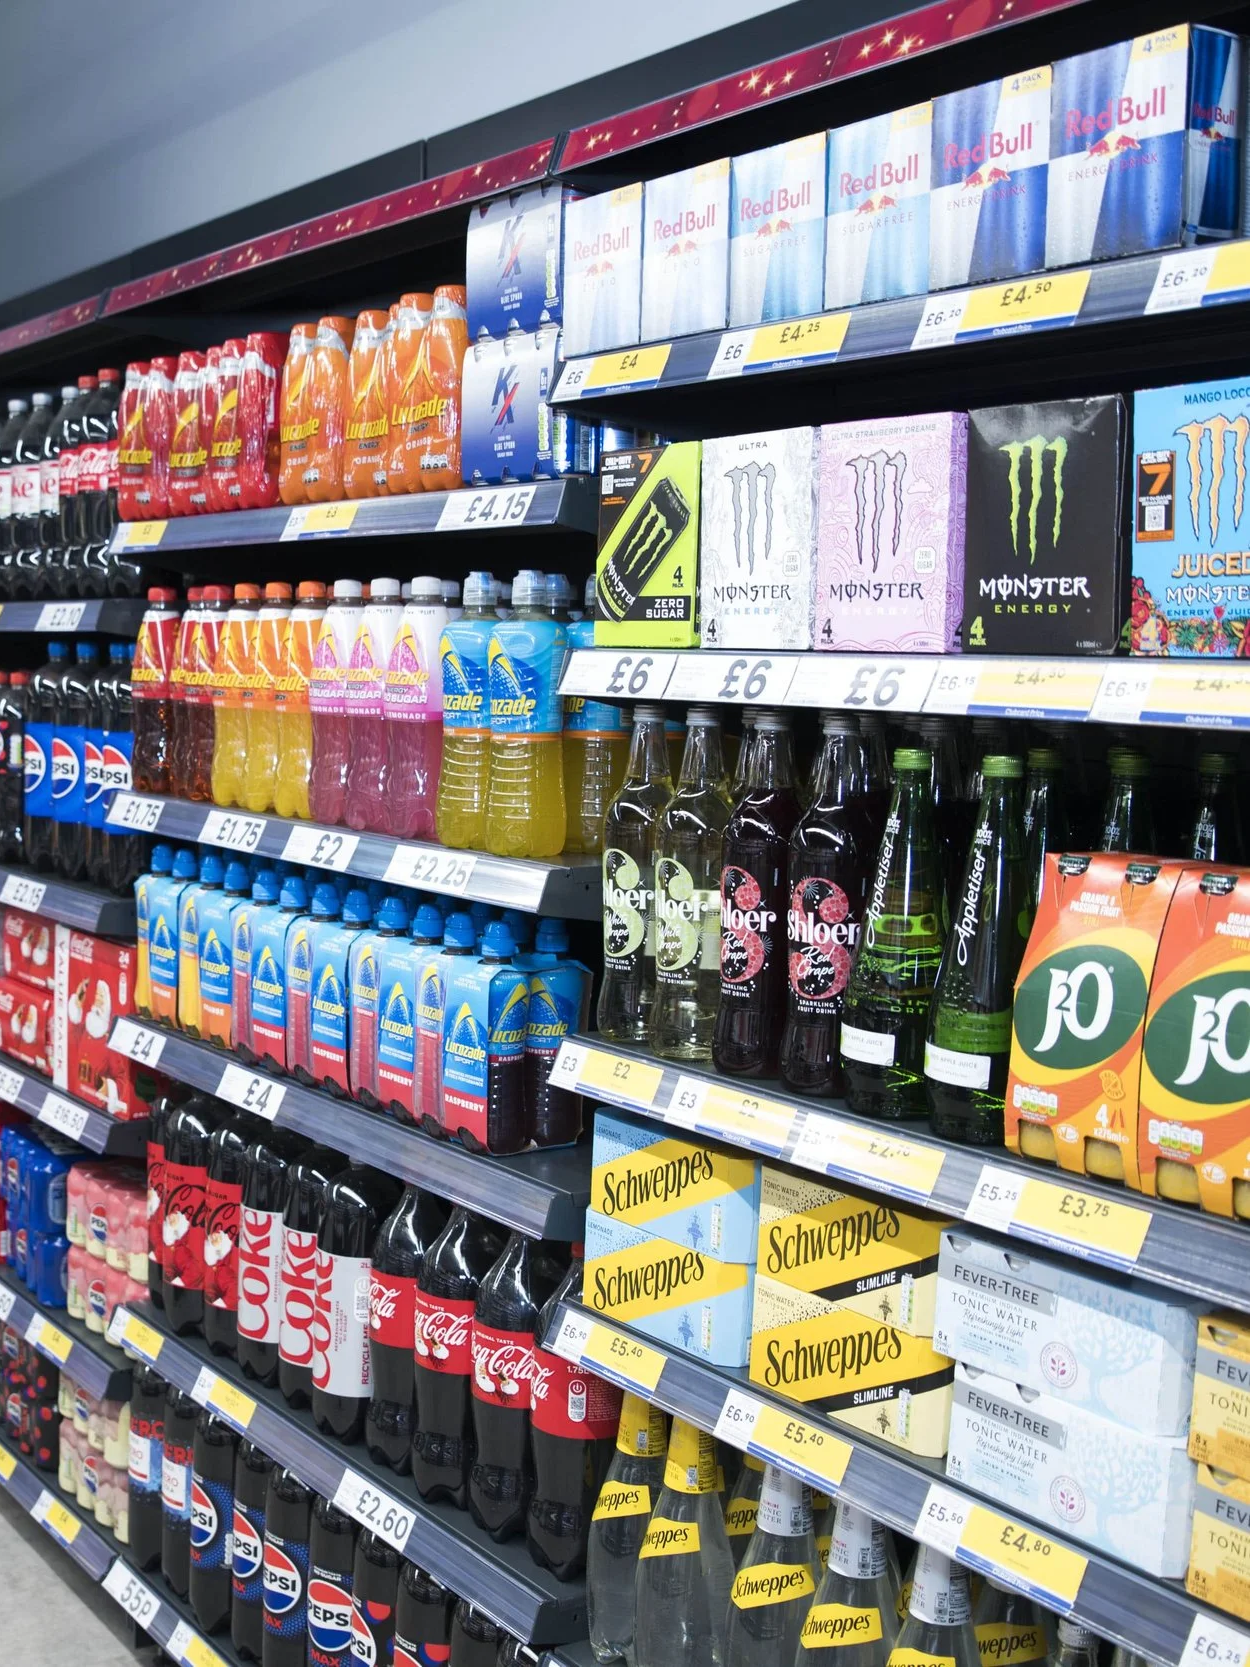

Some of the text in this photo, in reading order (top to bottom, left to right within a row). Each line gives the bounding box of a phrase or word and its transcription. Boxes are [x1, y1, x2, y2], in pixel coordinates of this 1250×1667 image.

[1155, 32, 1178, 45] PACK
[1066, 86, 1166, 139] Red Bull
[1193, 103, 1236, 126] Red Bull
[944, 122, 1032, 169] Red Bull
[840, 154, 918, 198] Red Bull
[1068, 162, 1114, 183] ENERGY
[741, 181, 811, 221] Red Bull
[654, 204, 715, 241] Red Bull
[842, 211, 914, 236] SUGARFREE
[574, 227, 629, 261] Red Bull
[620, 354, 638, 370] £4
[723, 343, 744, 360] £6
[566, 370, 582, 385] £6
[1184, 391, 1222, 405] MANGO
[738, 441, 768, 451] ULTRA
[464, 492, 530, 523] £4.15
[673, 566, 683, 582] 4
[713, 582, 792, 602] MONSTER
[829, 580, 924, 602] MONSTER
[979, 574, 1091, 600] MONSTER
[646, 608, 684, 618] SUGAR
[654, 599, 684, 608] ZERO
[995, 604, 1072, 613] ENERGY
[1228, 608, 1250, 616] JUIC
[707, 618, 717, 637] 4
[821, 618, 833, 637] 4
[970, 616, 984, 639] 4
[970, 638, 986, 646] PACK
[606, 656, 653, 695] £6
[718, 658, 772, 700] £6
[844, 665, 906, 708] £6
[390, 693, 427, 705] SUGAR
[122, 800, 160, 825] £1.75
[216, 817, 261, 847] £1.75
[976, 829, 993, 839] 100%
[311, 833, 344, 867] £2
[410, 855, 470, 888] £2.25
[13, 883, 43, 907] £2.15
[866, 840, 894, 947] Appletiser
[1080, 891, 1108, 904] ORANGE
[954, 851, 985, 966] Appletiser
[1070, 900, 1121, 918] PASSION FRUIT
[788, 909, 860, 945] Shloer
[723, 931, 748, 949] Red
[800, 946, 835, 963] Red
[798, 960, 834, 981] Grape
[313, 995, 345, 1017] Lucozade
[800, 1000, 834, 1008] SPARKLING
[1033, 961, 1114, 1052] J2O
[380, 1014, 413, 1038] Lucozade
[388, 1033, 406, 1042] SPORT
[130, 1031, 154, 1065] £4
[312, 1046, 344, 1063] RASPBERRY
[445, 1037, 486, 1061] Lucozade
[454, 1057, 475, 1065] SPORT
[561, 1055, 578, 1072] £3
[612, 1062, 631, 1080] £2
[379, 1069, 413, 1086] RASPBERRY
[242, 1077, 273, 1112] £4
[444, 1093, 485, 1113] RASPBERRY
[678, 1092, 698, 1108] £3
[1095, 1104, 1108, 1128] 4
[596, 1126, 621, 1141] LEMONADE
[603, 1150, 713, 1215] Schweppes
[764, 1179, 781, 1192] TONIC
[781, 1186, 799, 1198] WATER
[1059, 1194, 1110, 1218] £3.75
[588, 1220, 613, 1236] LEMONADE
[767, 1206, 900, 1274] Schweppes
[237, 1208, 273, 1340] Coke
[594, 1252, 704, 1310] Schweppes
[856, 1271, 896, 1293] SLIMLINE
[954, 1265, 1039, 1305] FEVER-TREE
[279, 1230, 317, 1365] Coke
[758, 1287, 795, 1308] TONIC WATER
[952, 1292, 1037, 1331] TONIC WATER
[964, 1308, 1005, 1333] Refreshingly
[362, 1325, 370, 1385] RECYCLE ME
[610, 1337, 643, 1358] £5.40
[764, 1327, 901, 1387] Schweppes
[853, 1385, 894, 1405] SLIMLINE
[726, 1404, 755, 1424] £6.90
[968, 1391, 1049, 1438] FEVER-TREE
[783, 1422, 824, 1447] £5.40
[966, 1418, 1001, 1442] TONIC
[1007, 1437, 1047, 1464] WATER
[977, 1435, 1016, 1461] Refreshingly
[356, 1490, 409, 1540] £2.60
[927, 1502, 964, 1525] £5.50
[1000, 1525, 1051, 1557] £4.80
[734, 1569, 805, 1599] Schweppes
[120, 1579, 152, 1616] 55p
[311, 1649, 341, 1667] MAX
[1194, 1636, 1241, 1665] £6.25
